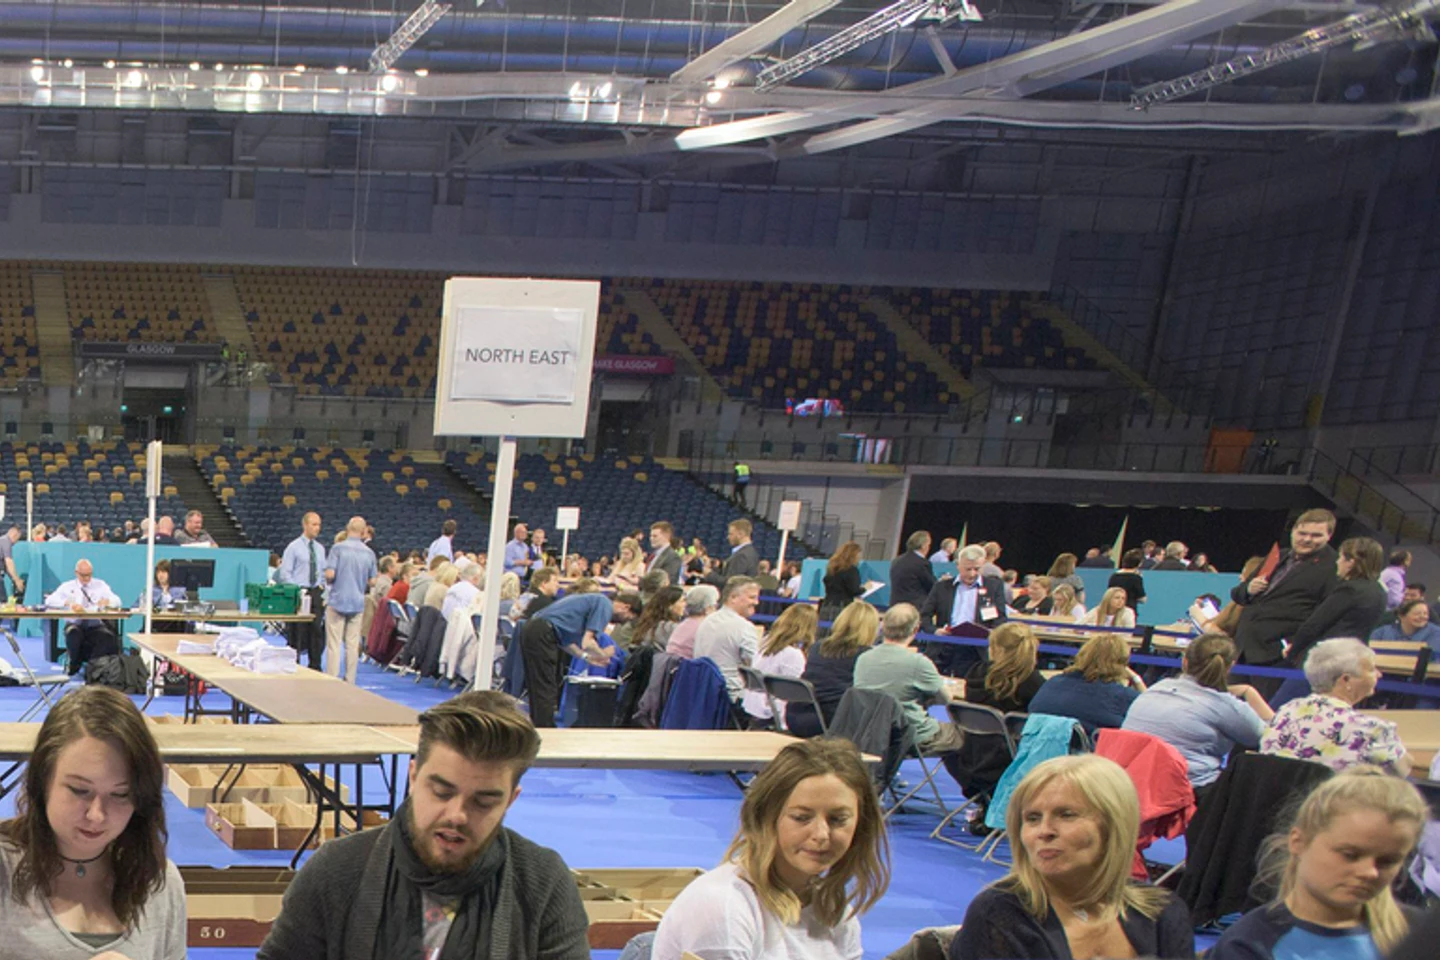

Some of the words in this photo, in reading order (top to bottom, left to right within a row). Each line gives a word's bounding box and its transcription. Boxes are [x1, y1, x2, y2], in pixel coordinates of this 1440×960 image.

[125, 343, 175, 354] GLASGOW
[464, 348, 525, 363] NORTH
[528, 350, 570, 366] EAST
[200, 926, 226, 939] 50
